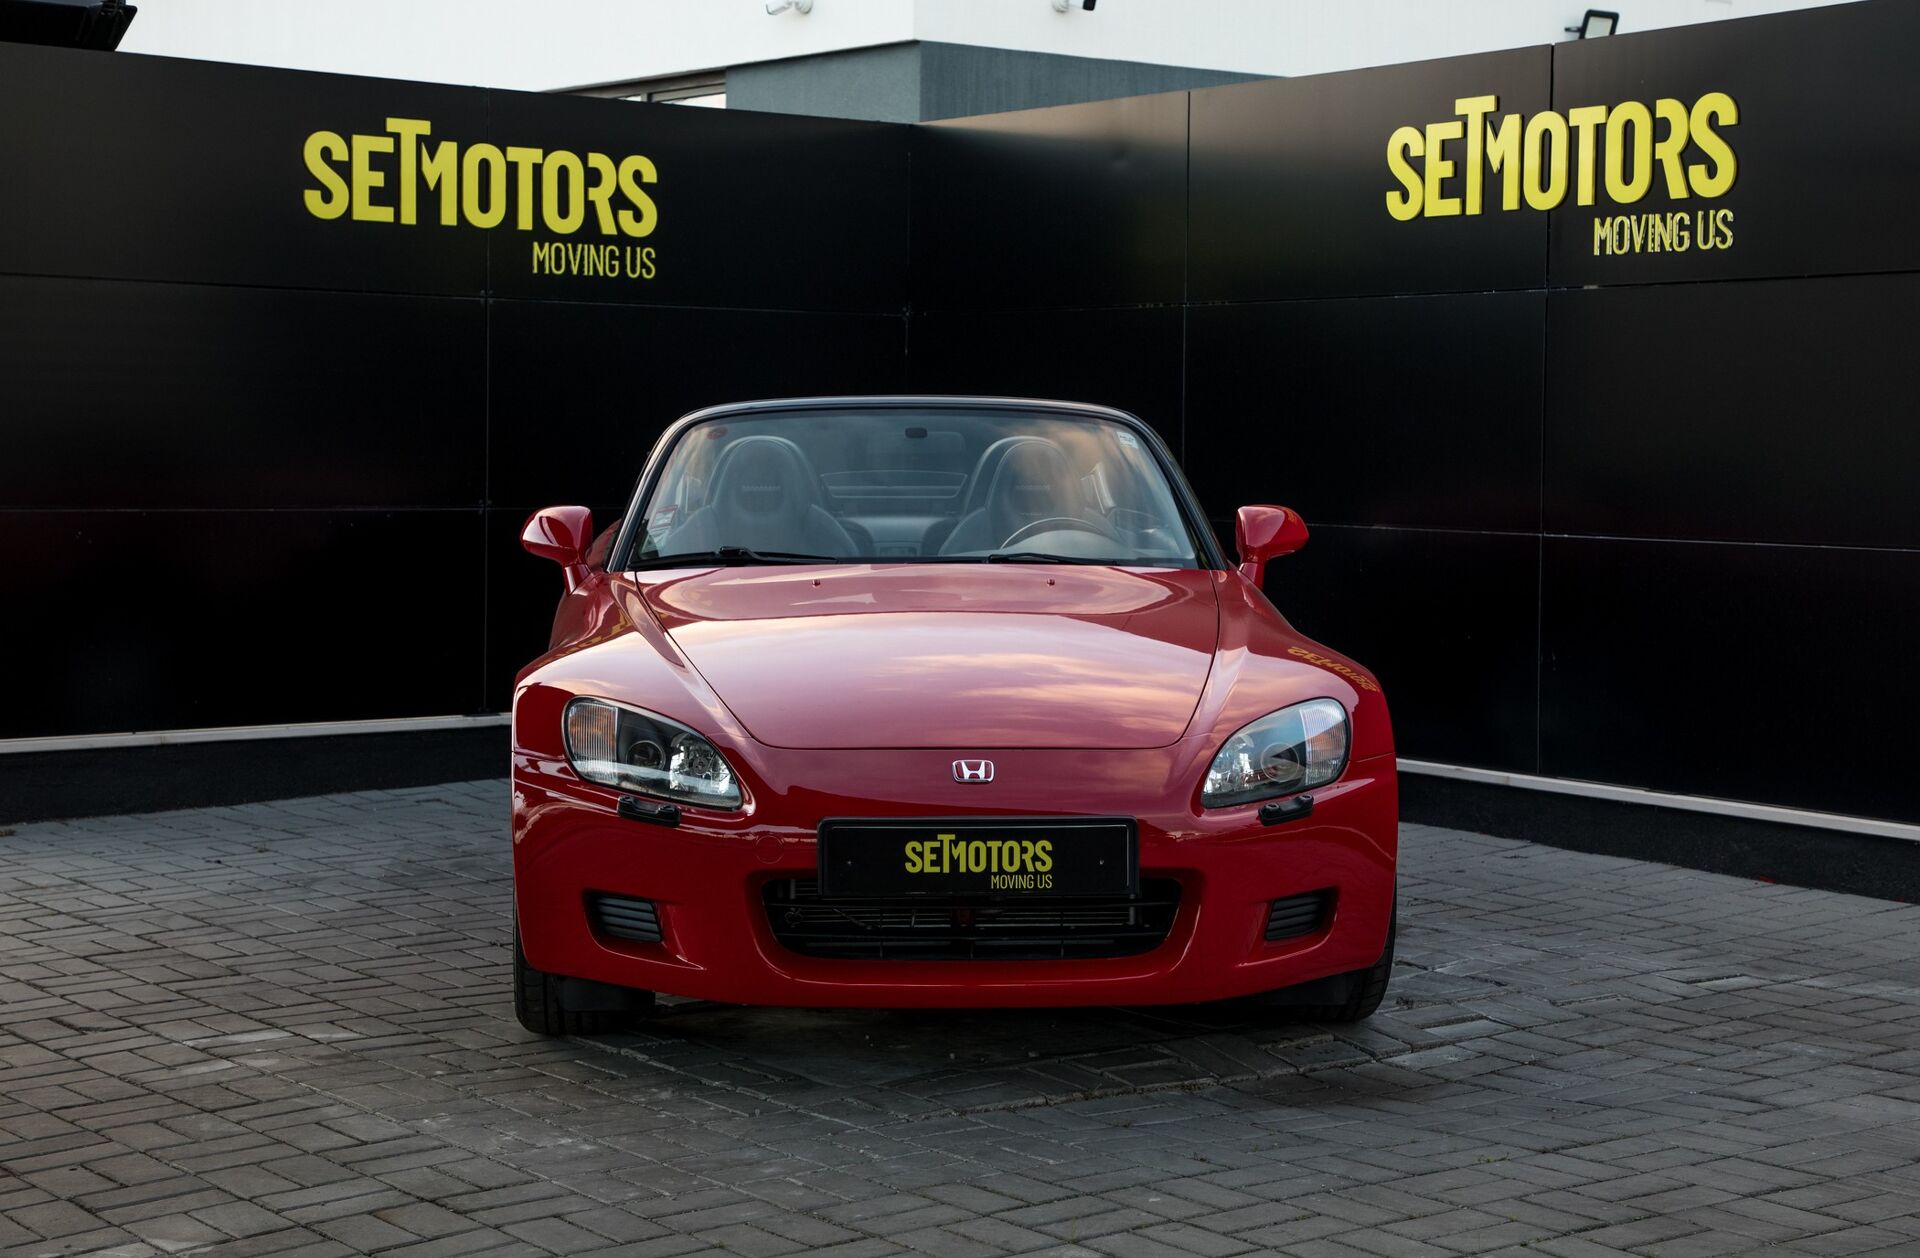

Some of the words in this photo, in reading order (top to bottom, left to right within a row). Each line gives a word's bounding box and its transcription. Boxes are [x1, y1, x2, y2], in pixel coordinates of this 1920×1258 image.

[303, 117, 658, 238] SETMOTORS
[1386, 92, 1738, 222] SETMOTORS
[1593, 212, 1691, 256] MOVING
[1697, 208, 1734, 250] US
[532, 242, 620, 278] MOVING
[626, 248, 656, 279] US
[904, 834, 1053, 873] SETMOTORS
[991, 874, 1034, 889] MOVING
[1037, 874, 1053, 889] US
